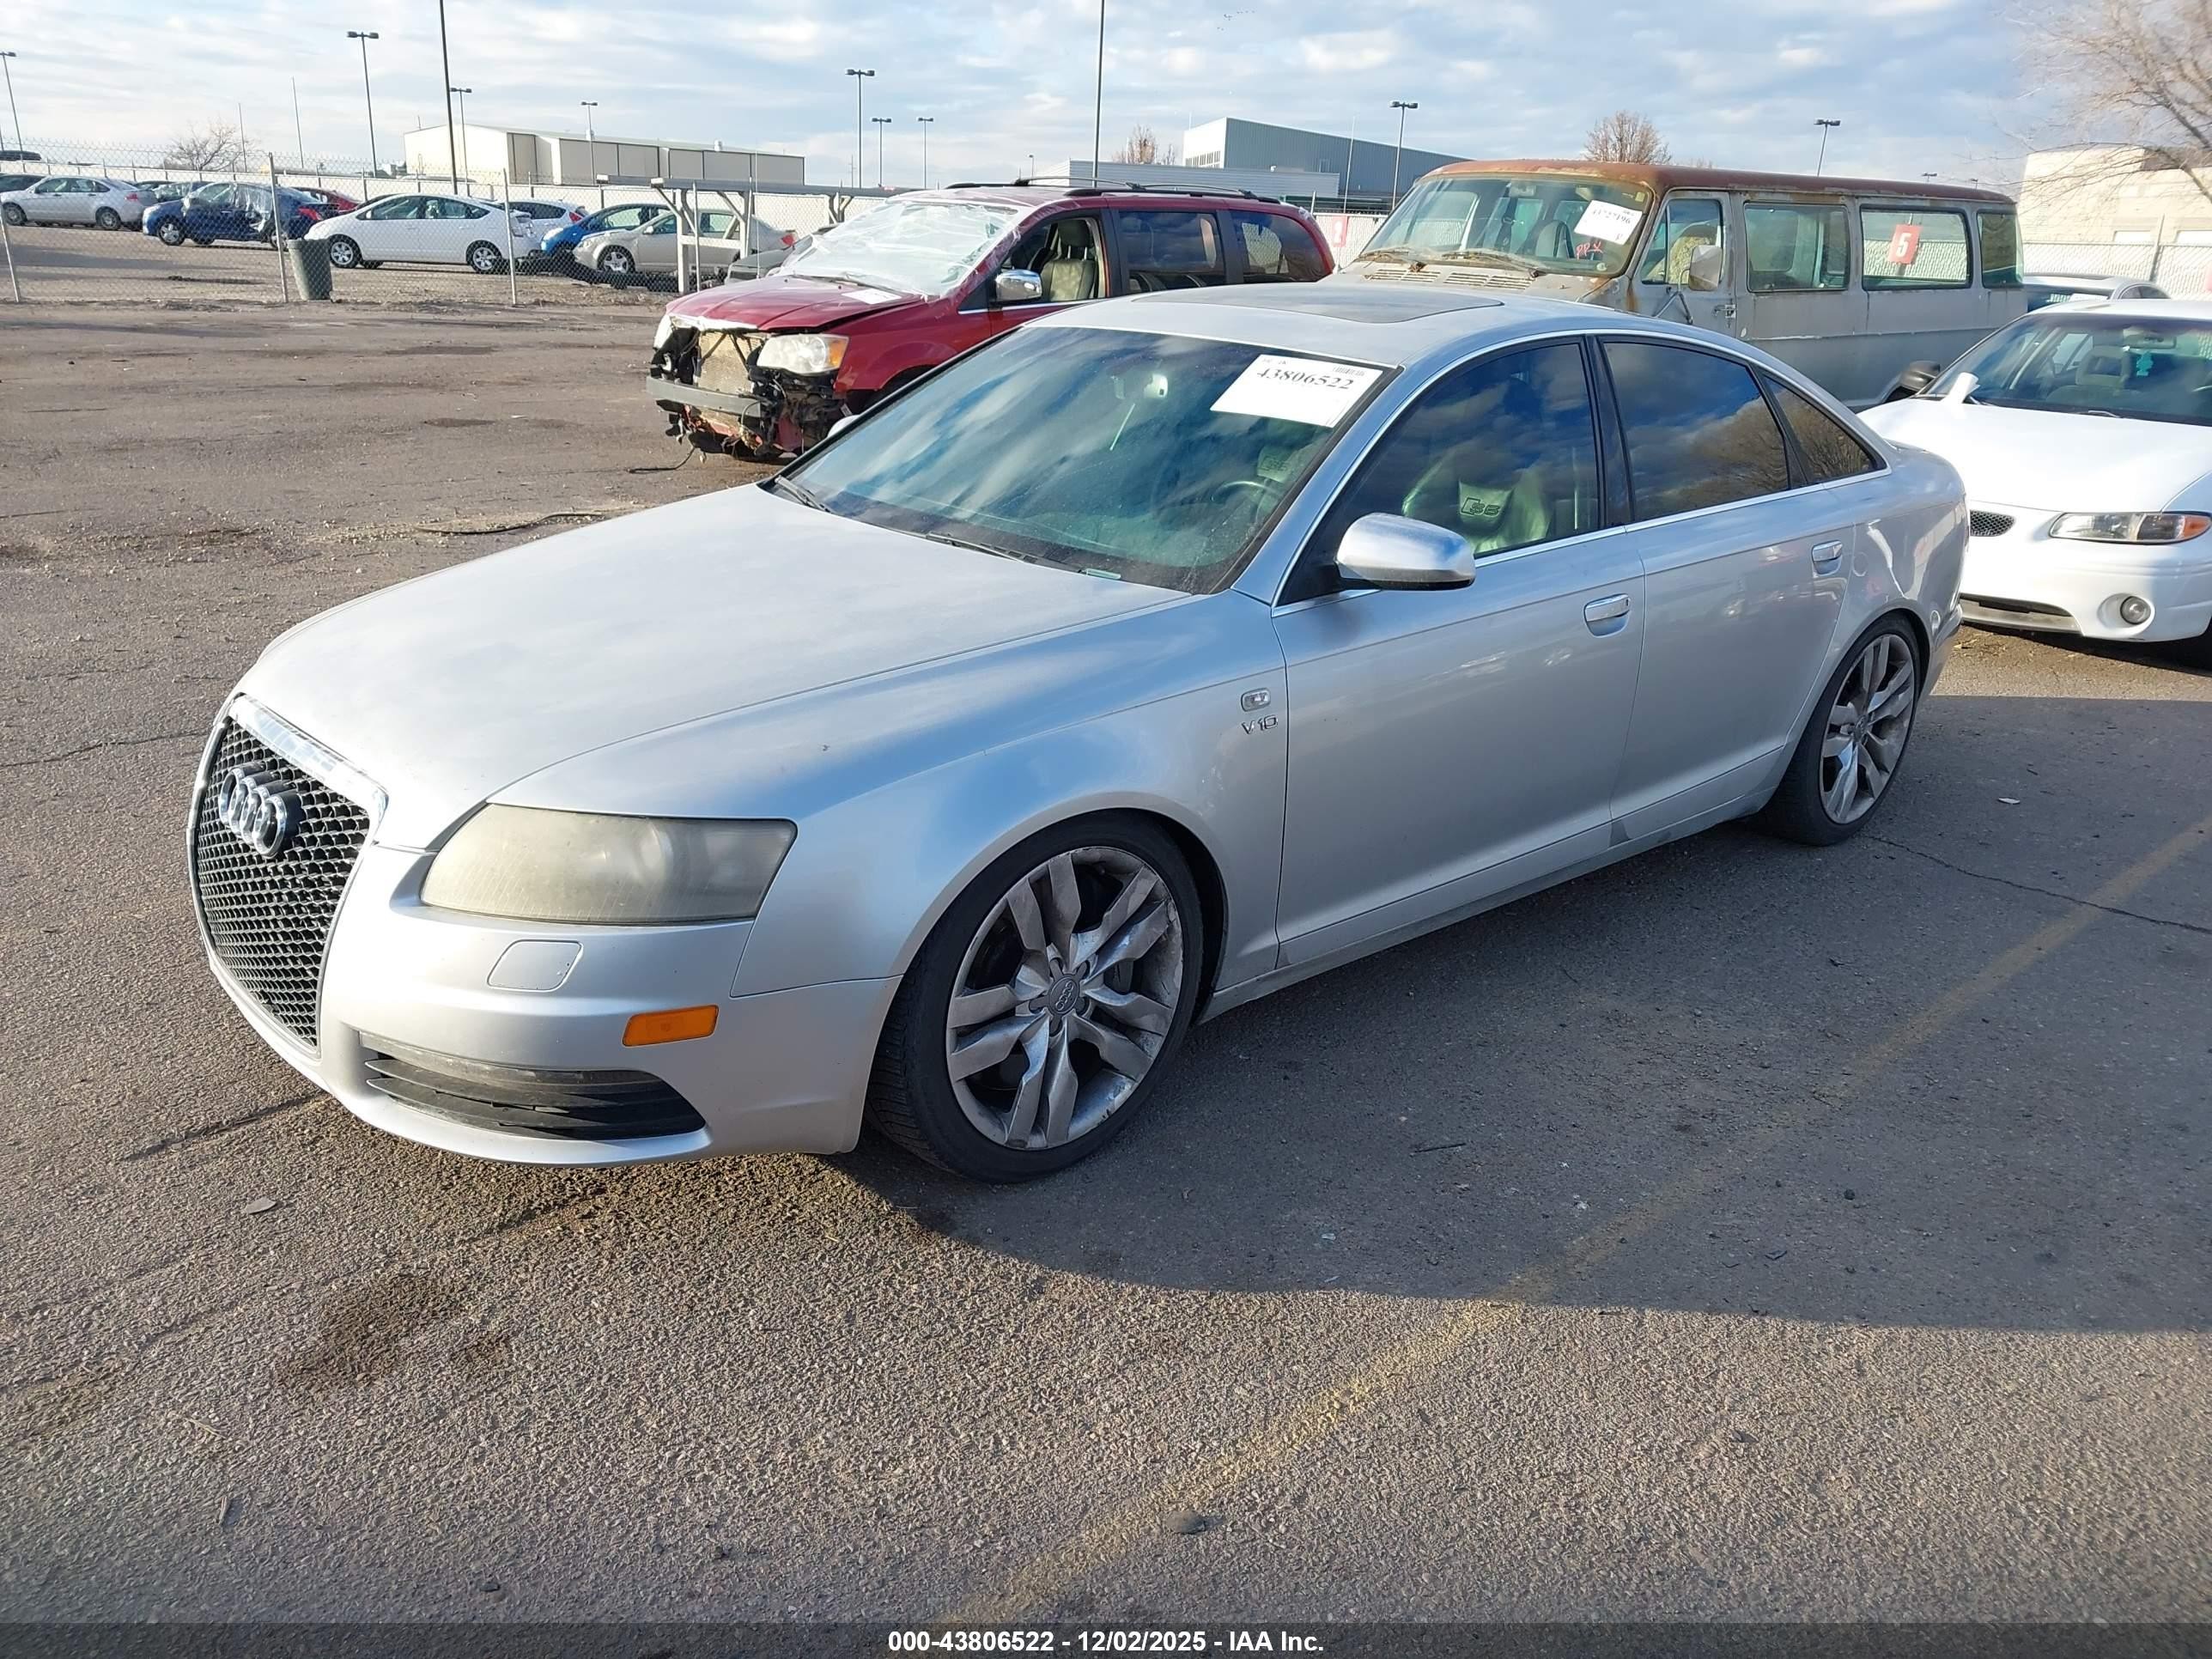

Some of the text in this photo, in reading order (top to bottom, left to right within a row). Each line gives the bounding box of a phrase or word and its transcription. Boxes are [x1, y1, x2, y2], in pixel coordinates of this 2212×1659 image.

[1895, 232, 1912, 258] 5
[1256, 368, 1354, 390] 43806522
[1241, 714, 1279, 735] V10
